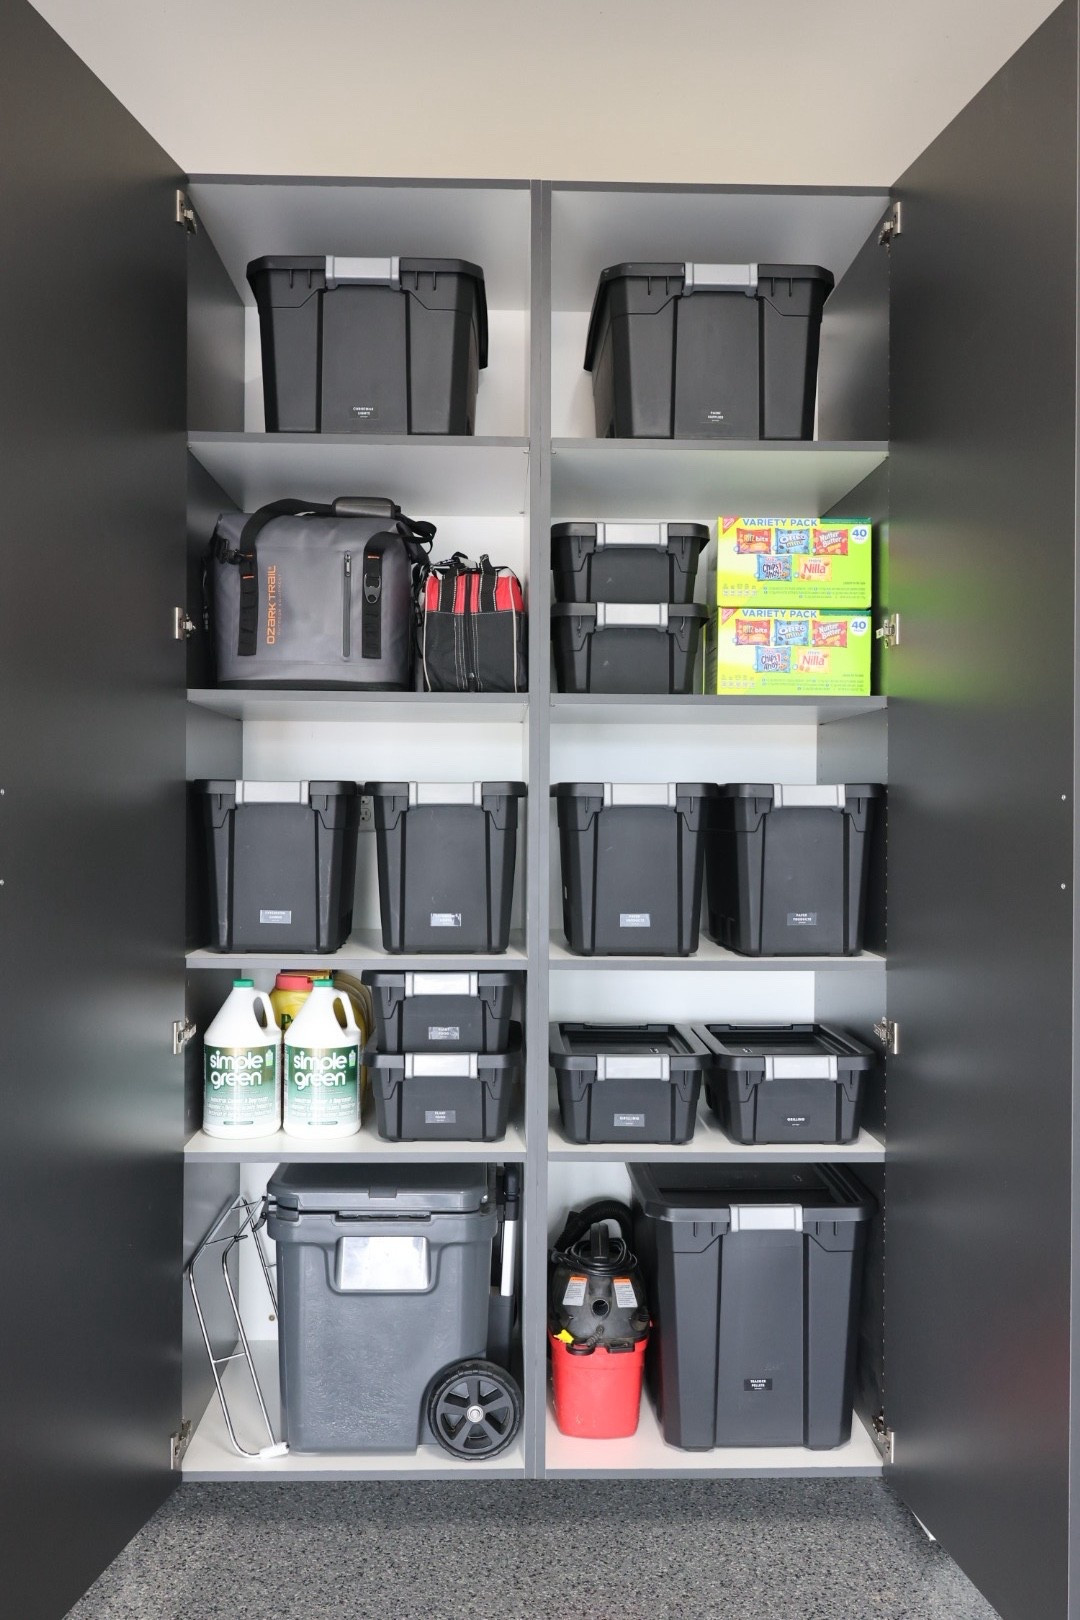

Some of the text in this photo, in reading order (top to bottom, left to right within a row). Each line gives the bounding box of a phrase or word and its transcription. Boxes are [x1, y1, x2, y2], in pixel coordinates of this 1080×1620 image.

[742, 518, 787, 527] VARIETY
[790, 518, 818, 527] PACK
[852, 529, 867, 538] 40
[803, 563, 826, 574] Nilla
[266, 565, 277, 645] OZARK TRAIL
[741, 609, 787, 618] VARIETY
[789, 609, 817, 618] PACK
[851, 621, 867, 630] 40
[802, 655, 825, 666] Nilla
[210, 1050, 264, 1075] simple
[293, 1050, 347, 1075] simple
[210, 1071, 262, 1091] green
[294, 1071, 346, 1091] green
